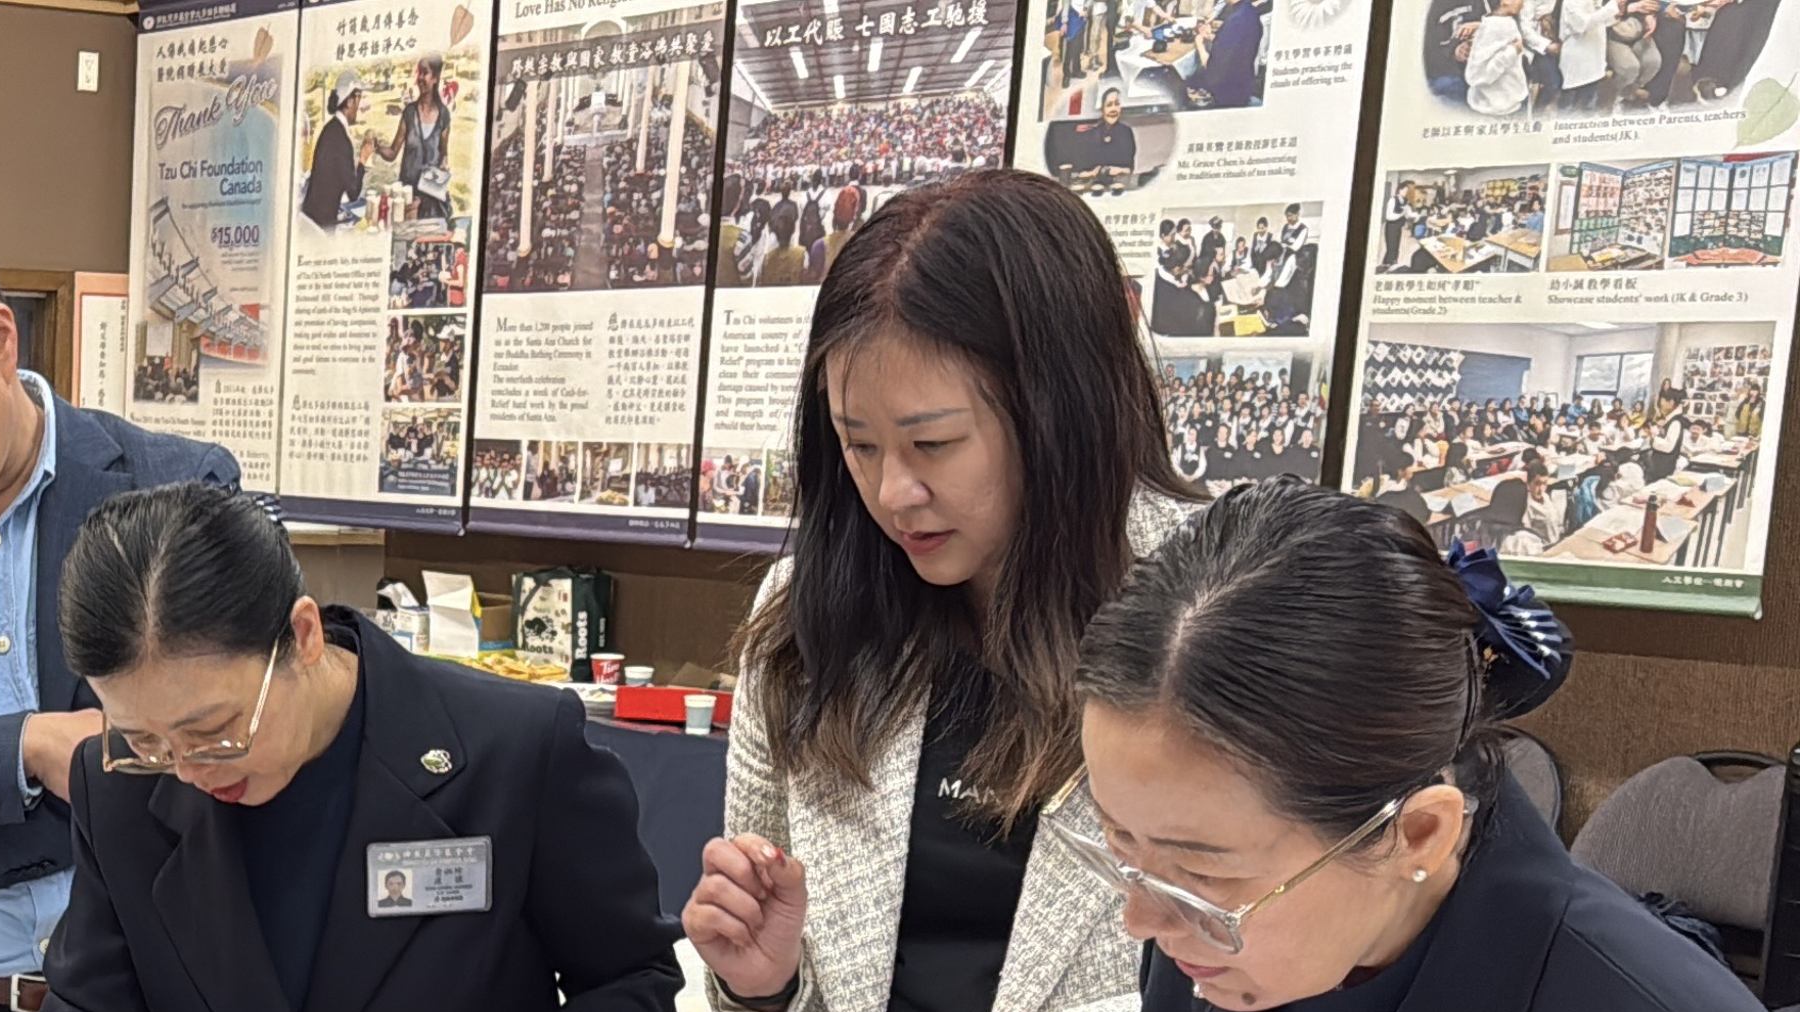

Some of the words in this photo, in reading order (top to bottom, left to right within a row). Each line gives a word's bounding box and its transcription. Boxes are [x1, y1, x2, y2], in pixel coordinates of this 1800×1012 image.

[515, 2, 541, 18] Love
[154, 96, 222, 150] Thank
[226, 74, 277, 127] You
[1554, 117, 1609, 131] Interaction
[1612, 116, 1656, 128] between
[1704, 110, 1747, 122] teachers
[1552, 133, 1570, 144] and
[159, 162, 177, 180] Tzu
[180, 160, 197, 179] Chi
[200, 156, 263, 177] Foundation
[220, 176, 263, 195] Canada
[211, 224, 259, 244] $15,000
[1439, 295, 1476, 303] between
[1478, 295, 1512, 303] teacher
[1548, 294, 1593, 304] Showcase
[1645, 294, 1668, 303] work
[1700, 292, 1733, 302] Grade
[575, 611, 589, 660] Roots
